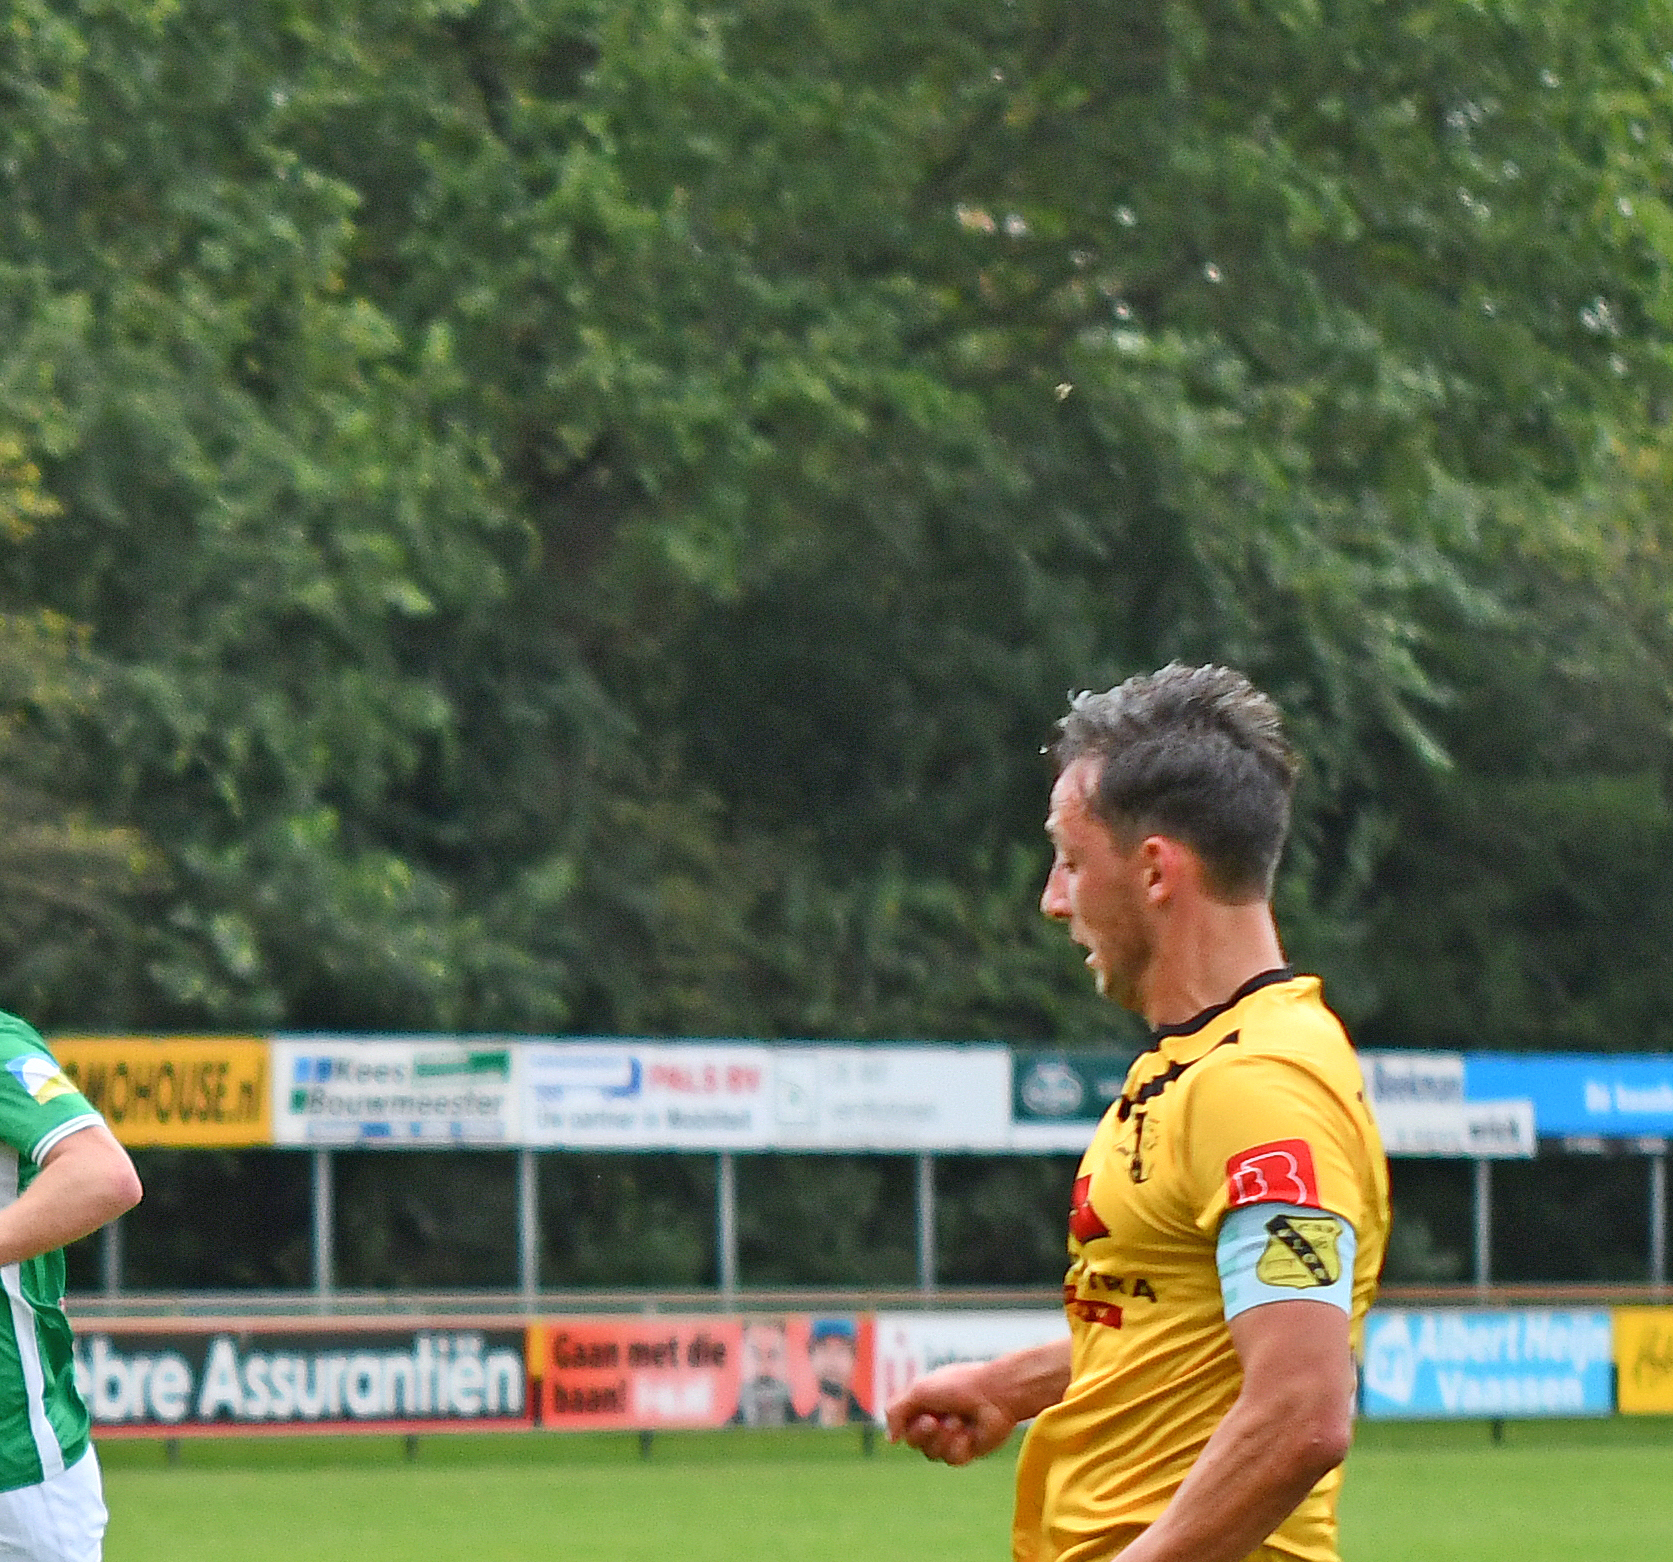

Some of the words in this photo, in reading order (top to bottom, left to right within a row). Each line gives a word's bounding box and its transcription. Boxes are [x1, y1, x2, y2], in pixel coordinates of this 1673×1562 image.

[337, 1055, 407, 1084] Kees
[307, 1088, 504, 1117] Bouwmeester
[553, 1333, 620, 1369] Gaan
[628, 1335, 679, 1368] met
[686, 1334, 728, 1368] die
[1419, 1310, 1520, 1362] Albert
[198, 1332, 526, 1421] Assurantiën
[1436, 1370, 1585, 1409] Vaassen
